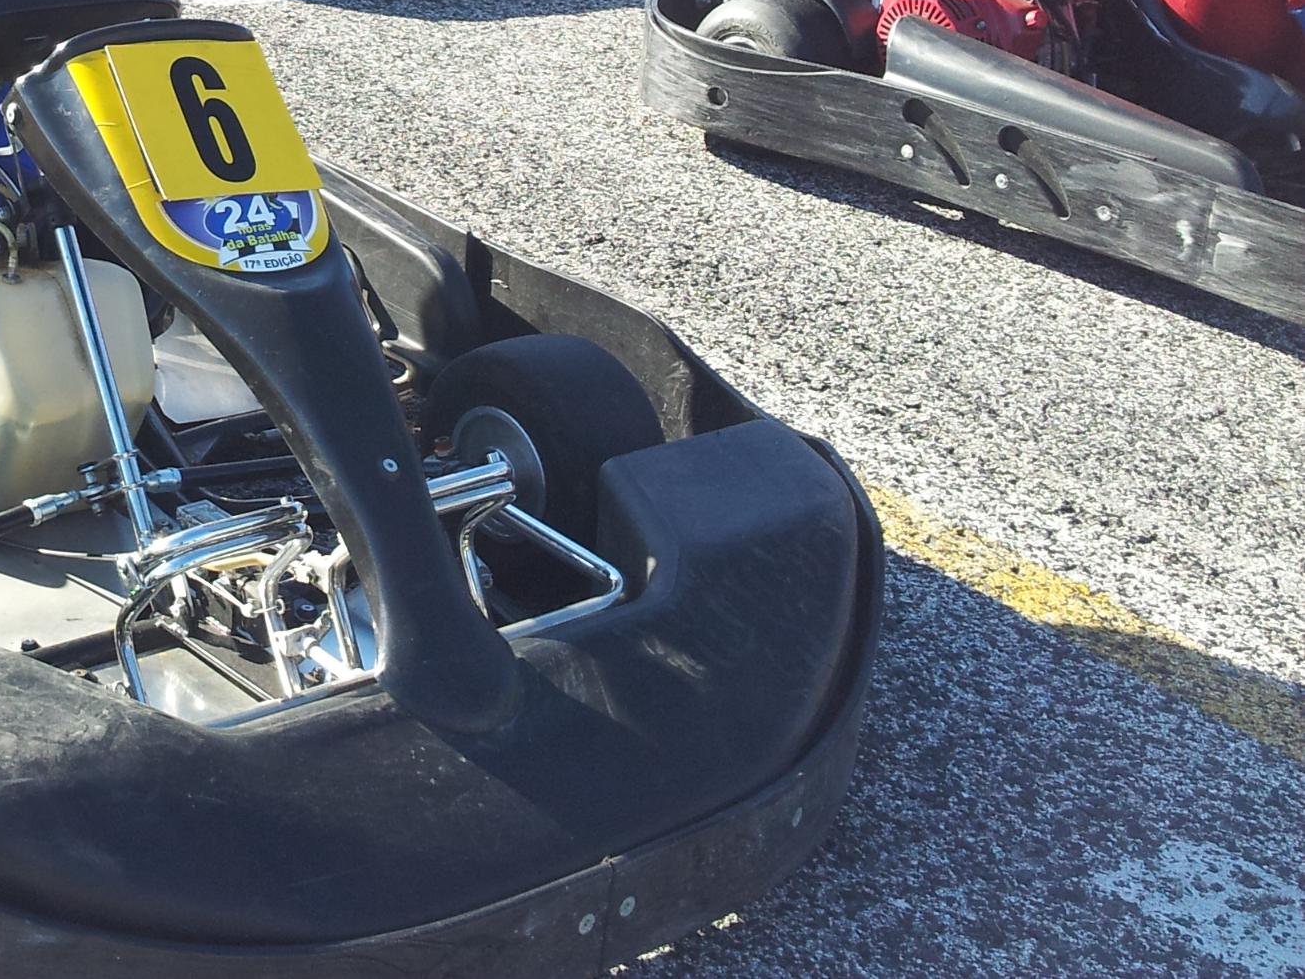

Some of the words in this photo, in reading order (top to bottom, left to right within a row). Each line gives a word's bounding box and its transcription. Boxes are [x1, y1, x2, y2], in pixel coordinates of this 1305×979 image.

[169, 55, 257, 183] 6
[215, 195, 277, 234] 24
[226, 238, 246, 251] da
[246, 229, 299, 247] Batalha
[264, 252, 303, 269] EDIÇÃO
